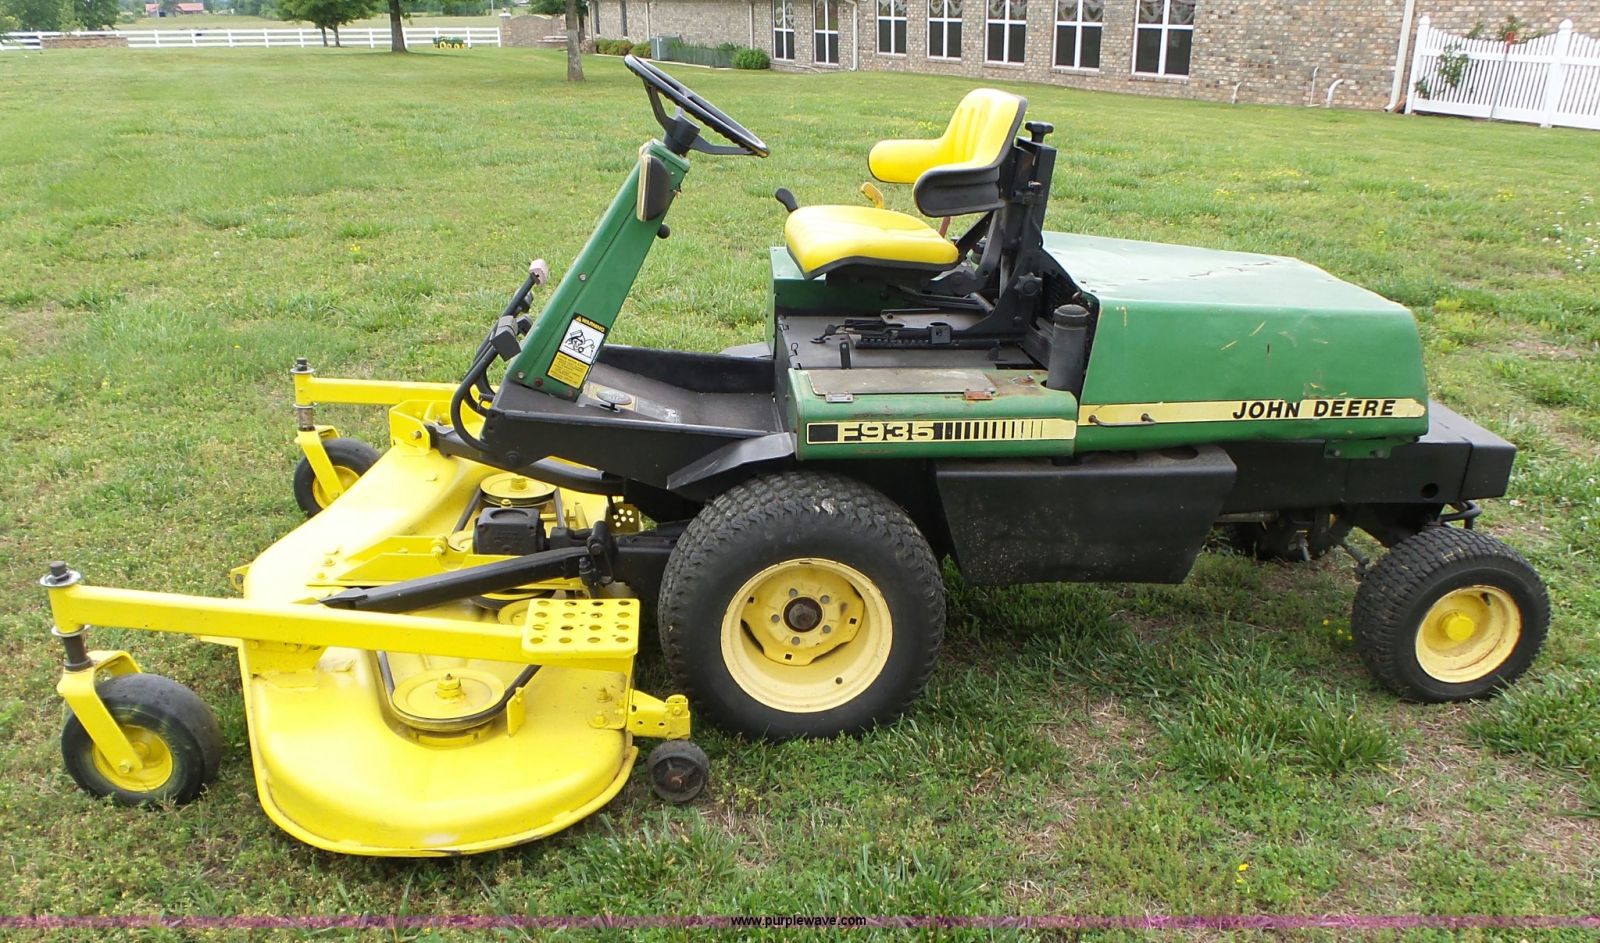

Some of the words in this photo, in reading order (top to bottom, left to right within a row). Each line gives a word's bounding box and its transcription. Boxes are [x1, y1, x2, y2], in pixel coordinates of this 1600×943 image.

[581, 317, 606, 333] WARNING
[1232, 401, 1300, 419] JOHN
[1313, 400, 1396, 417] DEERE
[837, 422, 935, 442] F935
